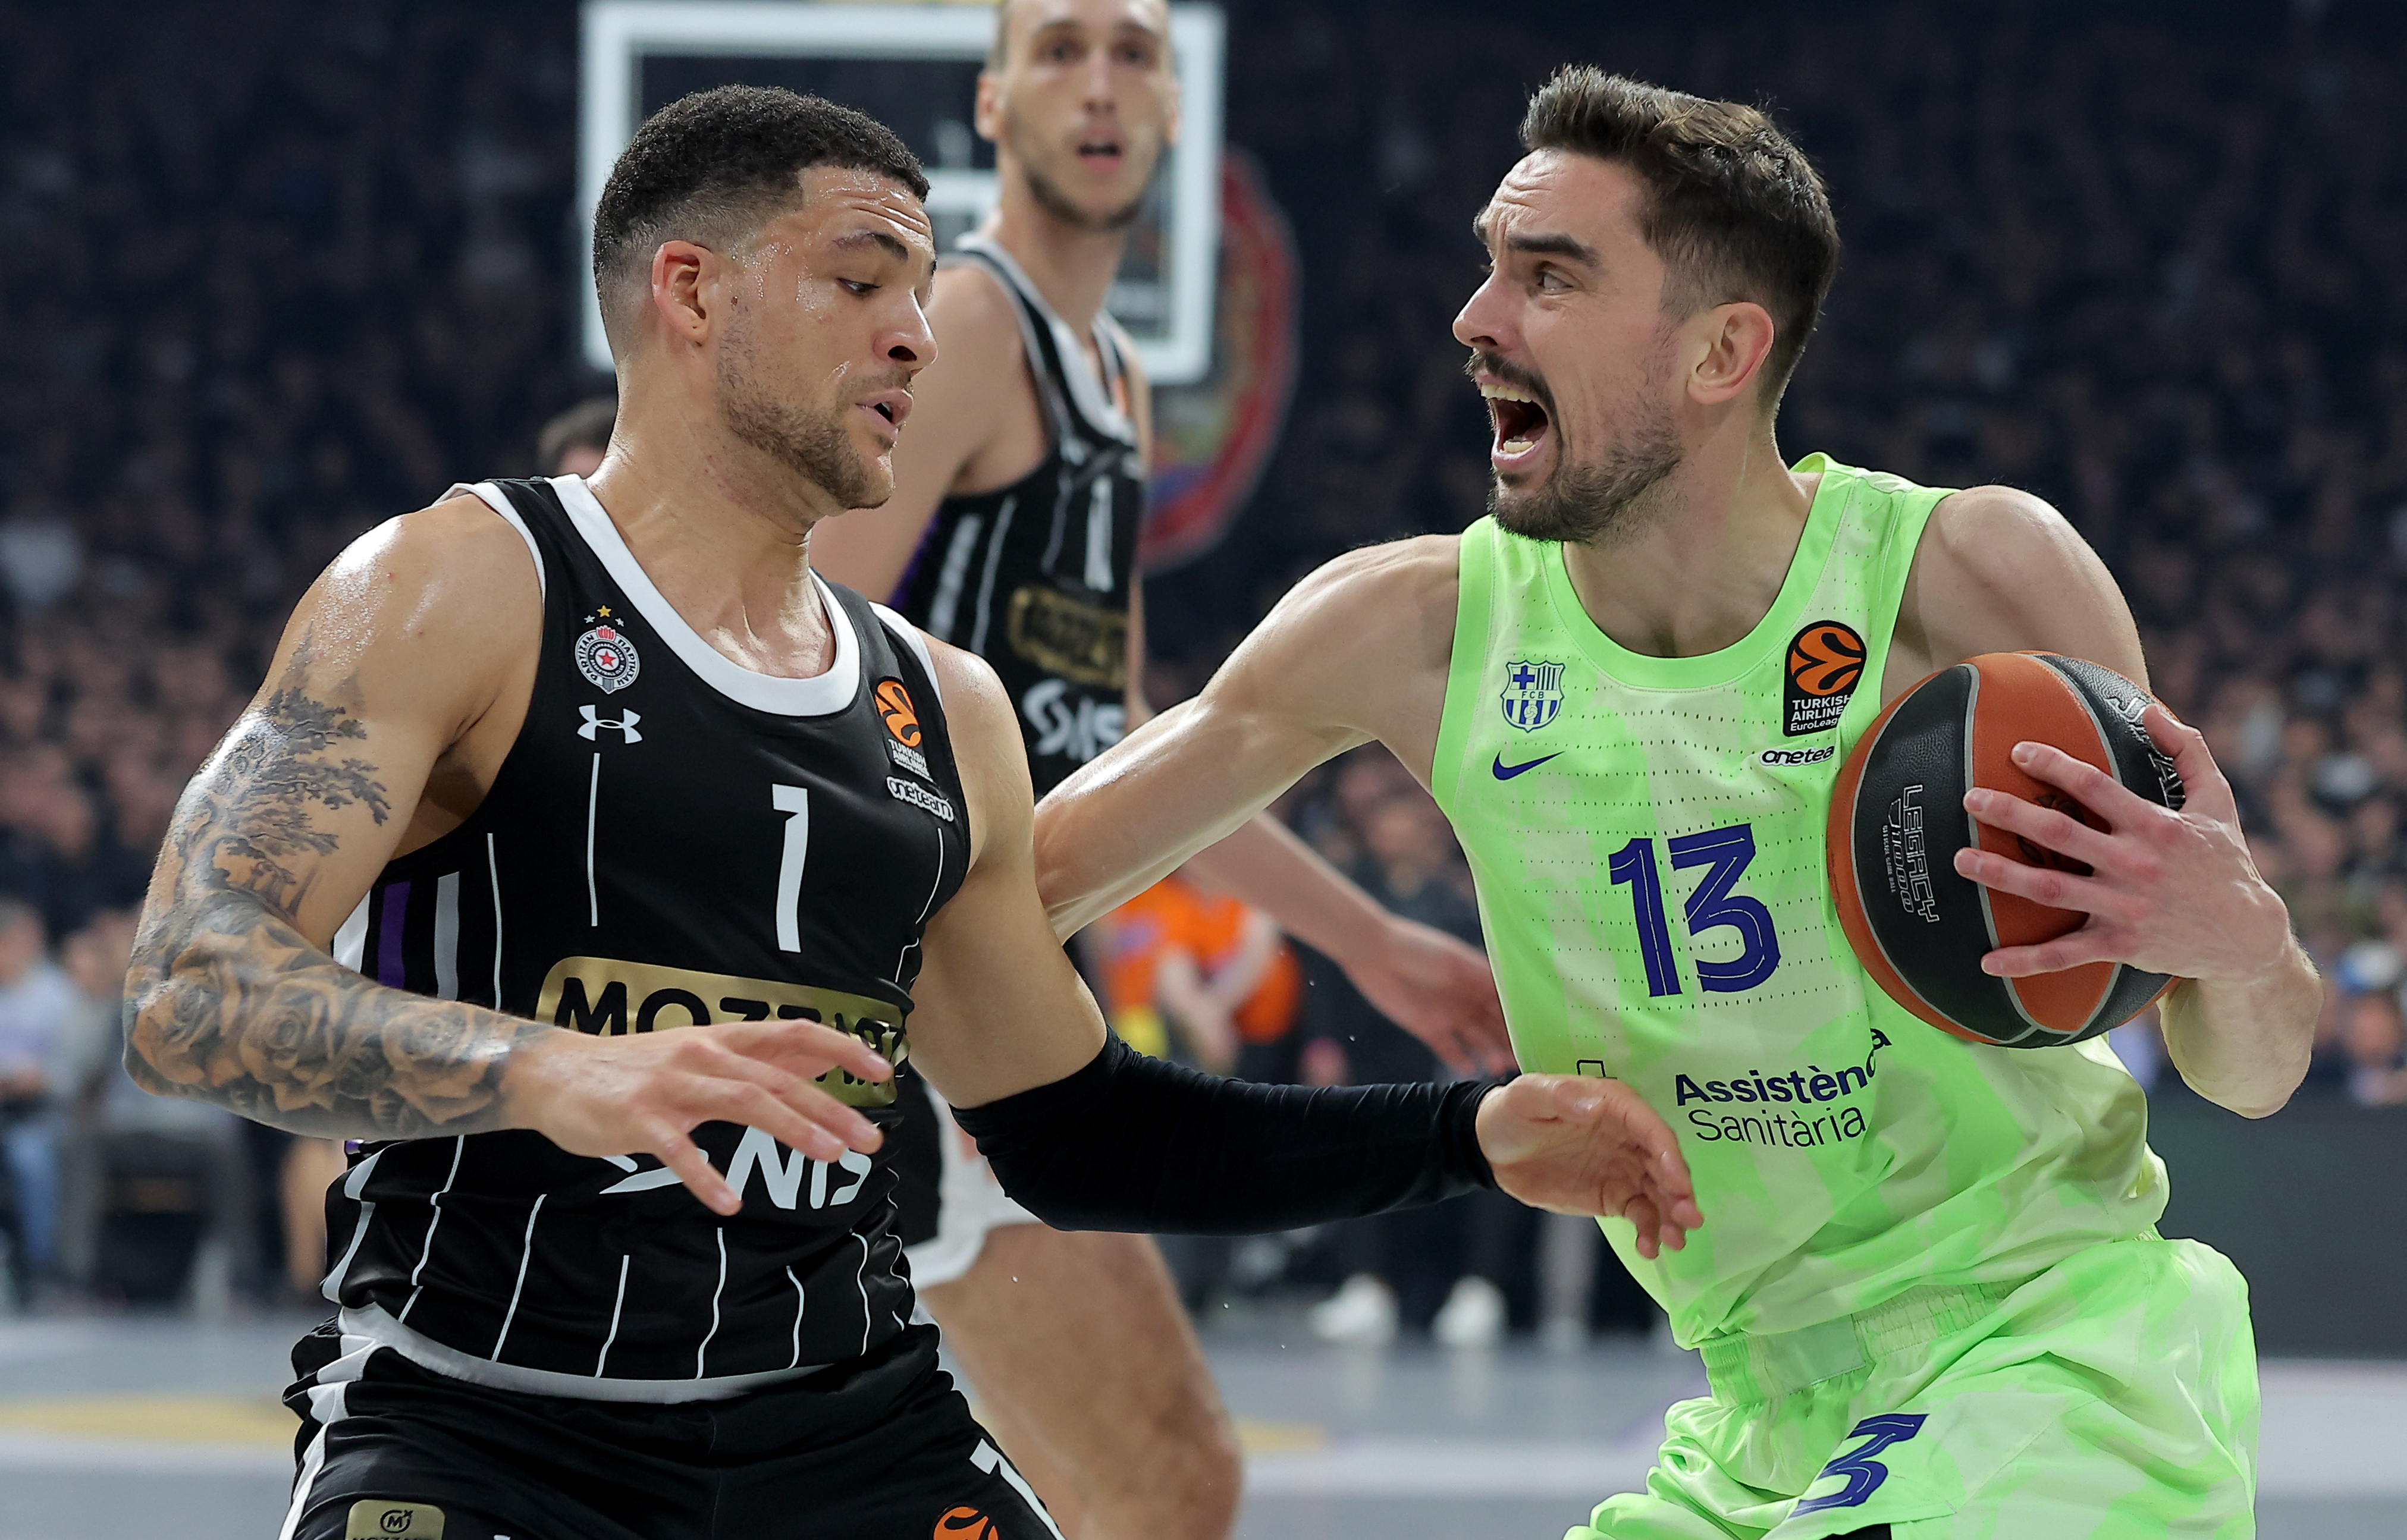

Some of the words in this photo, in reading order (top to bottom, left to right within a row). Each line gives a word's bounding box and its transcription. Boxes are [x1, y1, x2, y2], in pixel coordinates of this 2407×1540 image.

[1521, 691, 1544, 699] FCB
[1792, 694, 1851, 710] TURKISH
[1790, 718, 1838, 731] EuroLeag
[1791, 705, 1844, 722] AIRLINE
[888, 738, 927, 768] TURKISH
[1762, 745, 1835, 764] onetea
[889, 780, 952, 818] oneteam
[772, 783, 809, 953] 1
[1903, 784, 1940, 923] LEGACY
[1608, 823, 1781, 997] 13
[1687, 1107, 1866, 1148] Sanitària
